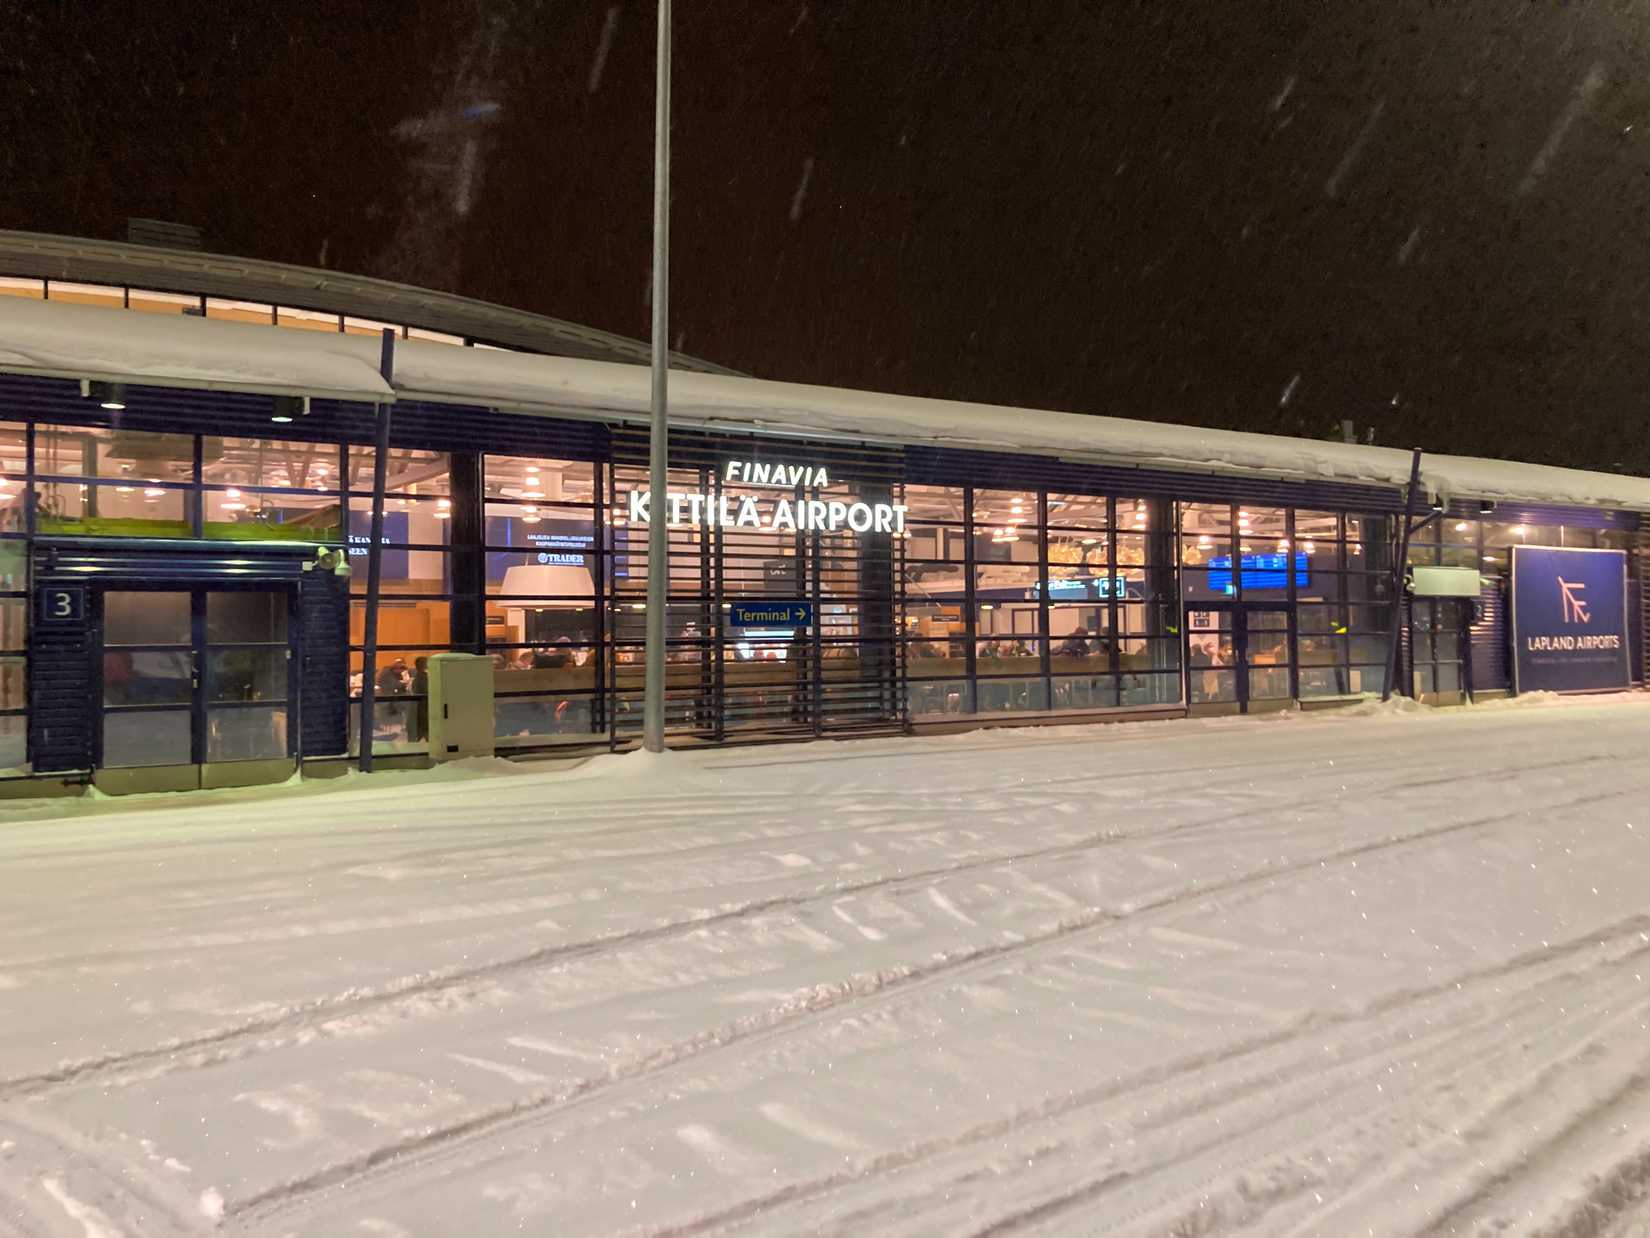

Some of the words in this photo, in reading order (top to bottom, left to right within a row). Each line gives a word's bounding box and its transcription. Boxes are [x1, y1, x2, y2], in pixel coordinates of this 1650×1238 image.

[725, 460, 829, 488] FINAVIA
[629, 489, 761, 528] KTTILÄ
[772, 498, 908, 533] AIRPORT
[547, 553, 585, 563] TRADER
[54, 592, 72, 616] 3
[735, 607, 790, 622] Terminal
[1528, 636, 1575, 651] LAPLAND
[1576, 634, 1620, 649] AIRPORTS
